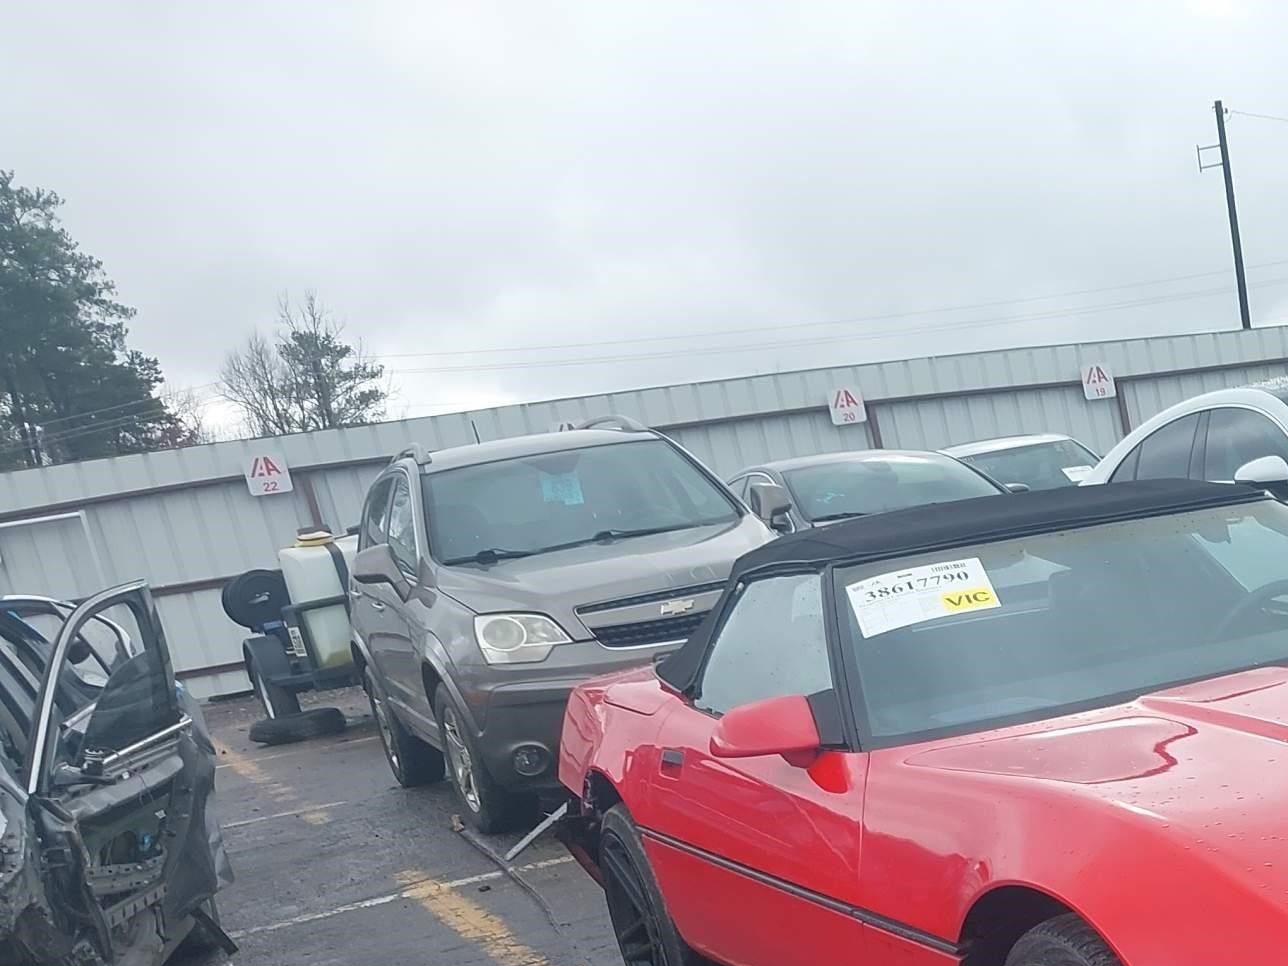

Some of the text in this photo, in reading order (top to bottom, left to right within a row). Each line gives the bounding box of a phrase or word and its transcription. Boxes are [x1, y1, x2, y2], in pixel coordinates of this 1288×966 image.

[842, 412, 856, 422] 20
[263, 481, 280, 492] 22
[865, 570, 970, 603] 38617790
[944, 591, 991, 607] VIC
